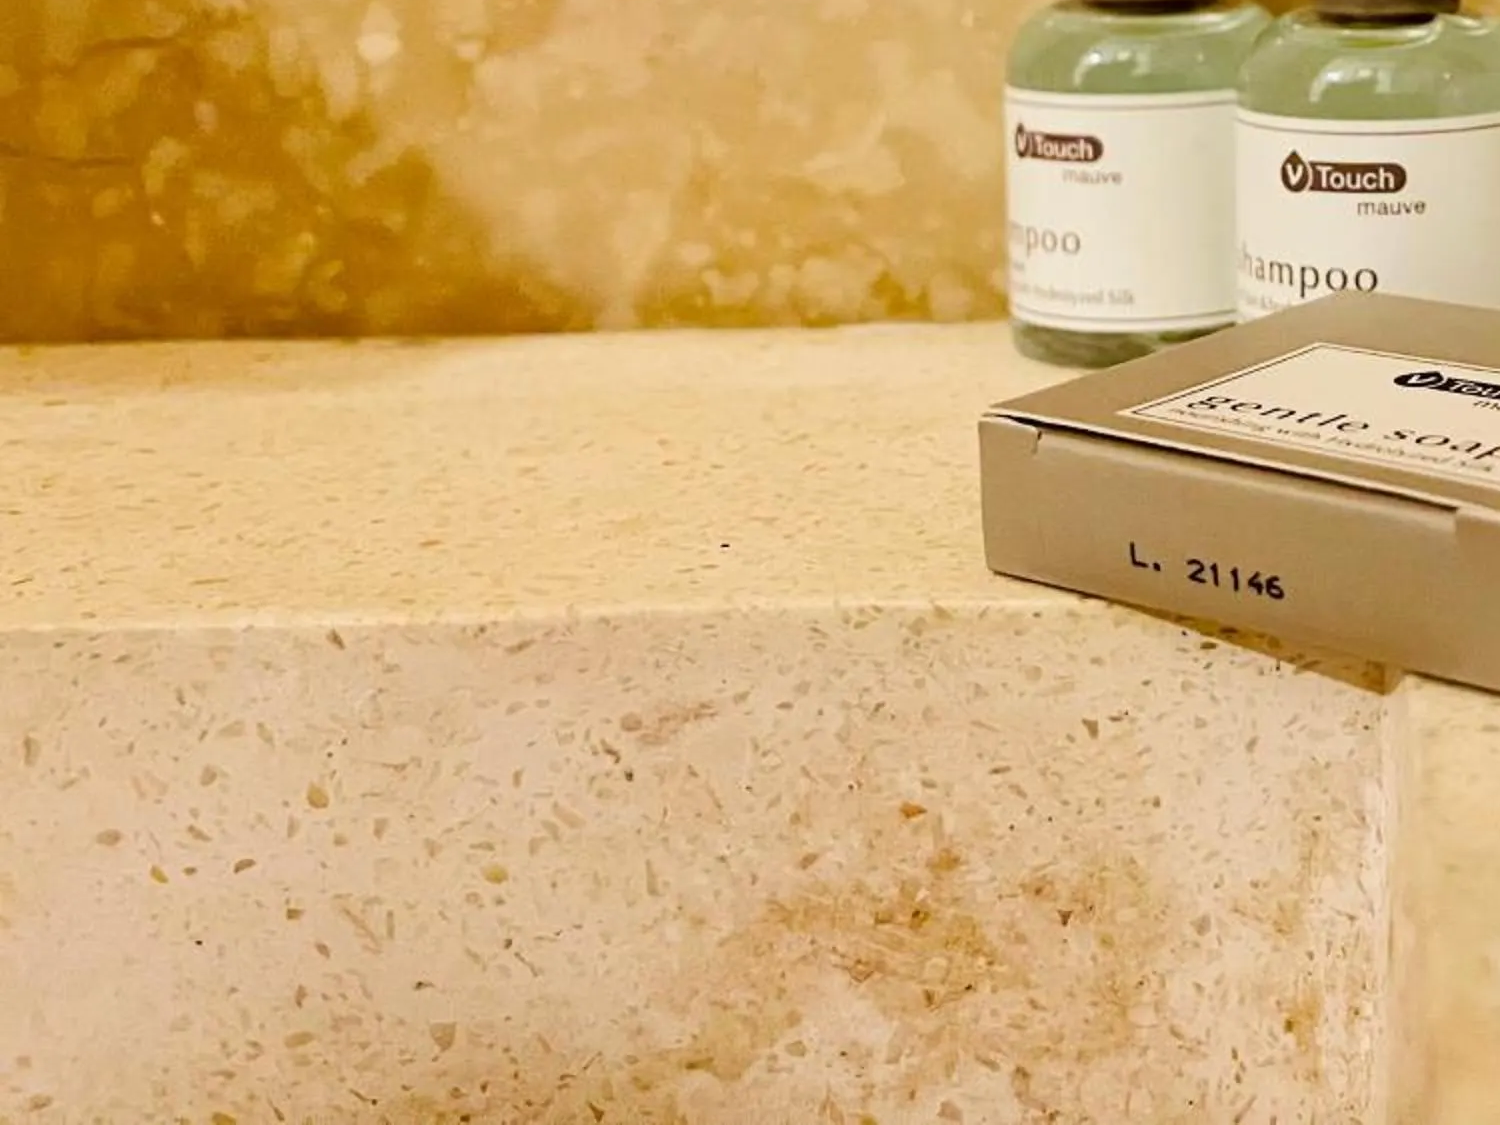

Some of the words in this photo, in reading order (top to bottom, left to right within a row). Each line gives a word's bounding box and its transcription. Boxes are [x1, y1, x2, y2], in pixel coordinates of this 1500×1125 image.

[1034, 134, 1094, 160] Touch
[1062, 168, 1122, 185] mauve
[1315, 165, 1396, 191] Touch
[1356, 199, 1427, 216] mauve
[1238, 240, 1379, 298] hampoo
[1186, 395, 1370, 433] gentle
[1129, 540, 1162, 573] L.
[1186, 558, 1286, 601] 21146
